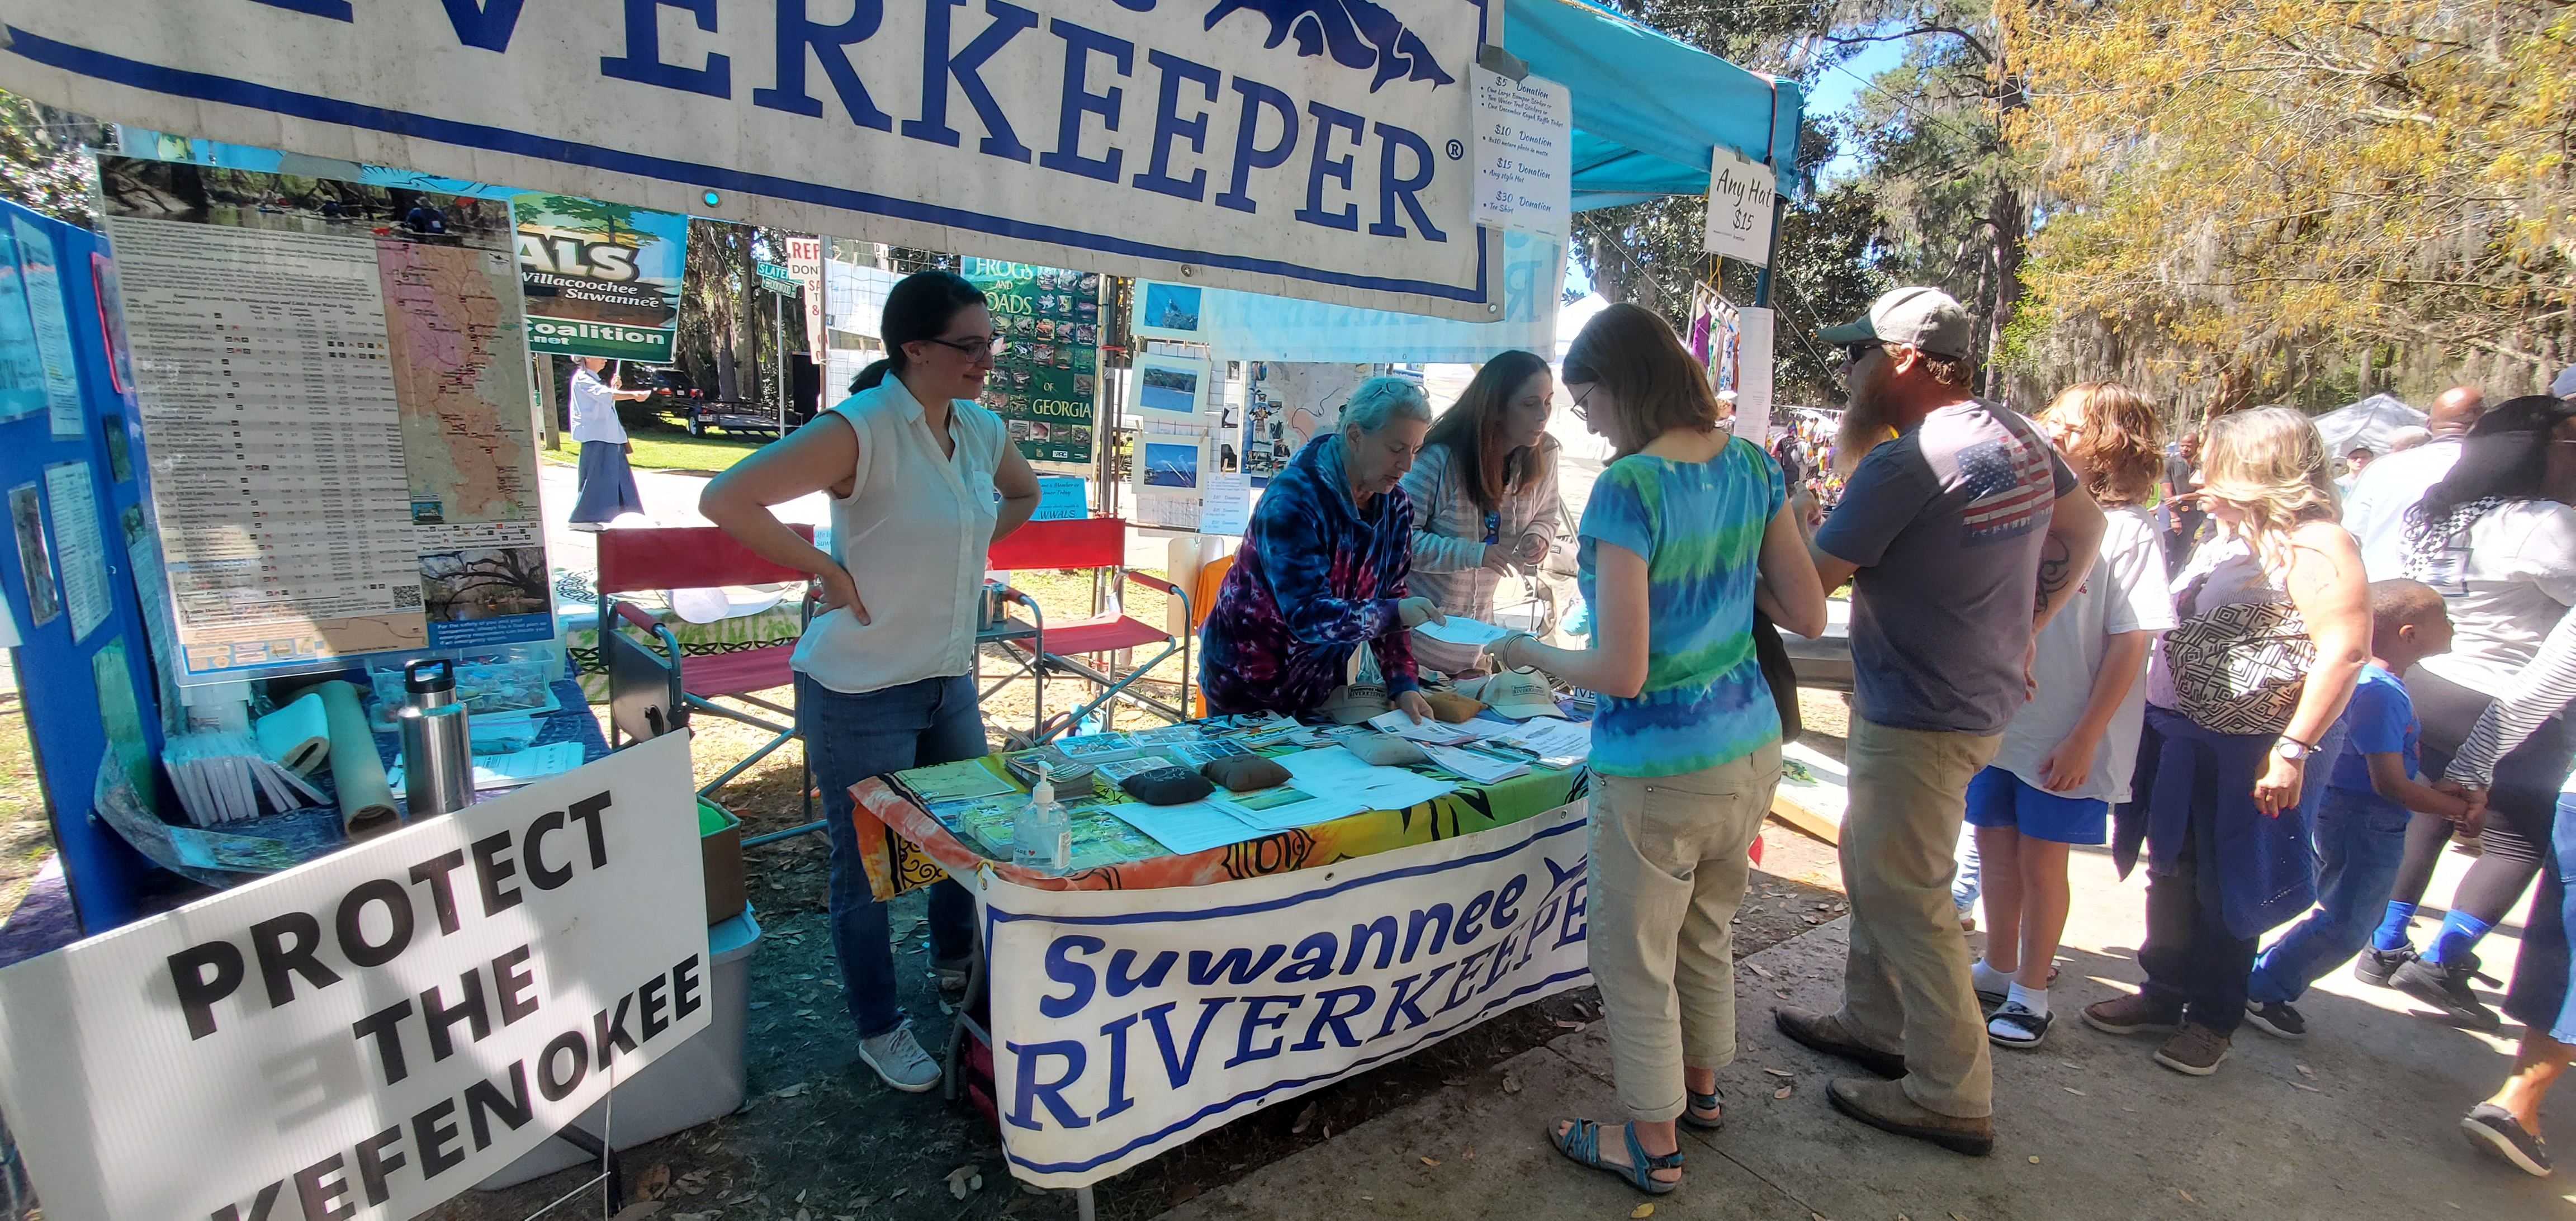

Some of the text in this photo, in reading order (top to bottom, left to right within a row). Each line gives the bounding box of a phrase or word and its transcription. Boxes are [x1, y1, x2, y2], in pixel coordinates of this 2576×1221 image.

[1495, 76, 1549, 100] $5 Donation
[1498, 88, 1510, 98] Large
[1498, 97, 1512, 105] Water
[1499, 105, 1522, 116] December
[1522, 112, 1536, 121] Kayak
[1537, 115, 1550, 125] Raffle
[1551, 119, 1564, 127] Ticket
[1494, 124, 1552, 148] $10 Donation
[1489, 169, 1500, 180] Any
[1501, 173, 1514, 182] style
[1497, 157, 1550, 179] $15 Donation
[1716, 168, 1772, 208] Any Hat
[1495, 191, 1551, 212] $30 Donation
[1499, 204, 1514, 215] Shirt
[1733, 207, 1754, 231] $15
[759, 264, 788, 280] SLATE
[976, 258, 1034, 280] FROGS
[995, 280, 1013, 290] AND
[565, 288, 660, 307] Suwannee
[983, 291, 1033, 315] OADS
[1043, 382, 1054, 391] OF
[1033, 399, 1092, 418] GEORGIA
[1040, 510, 1076, 519] WWALS
[167, 789, 612, 1041] PROTECT
[1039, 873, 1528, 1019] Suwannee
[353, 943, 539, 1087] THE
[210, 953, 701, 1221] EFENOKEE
